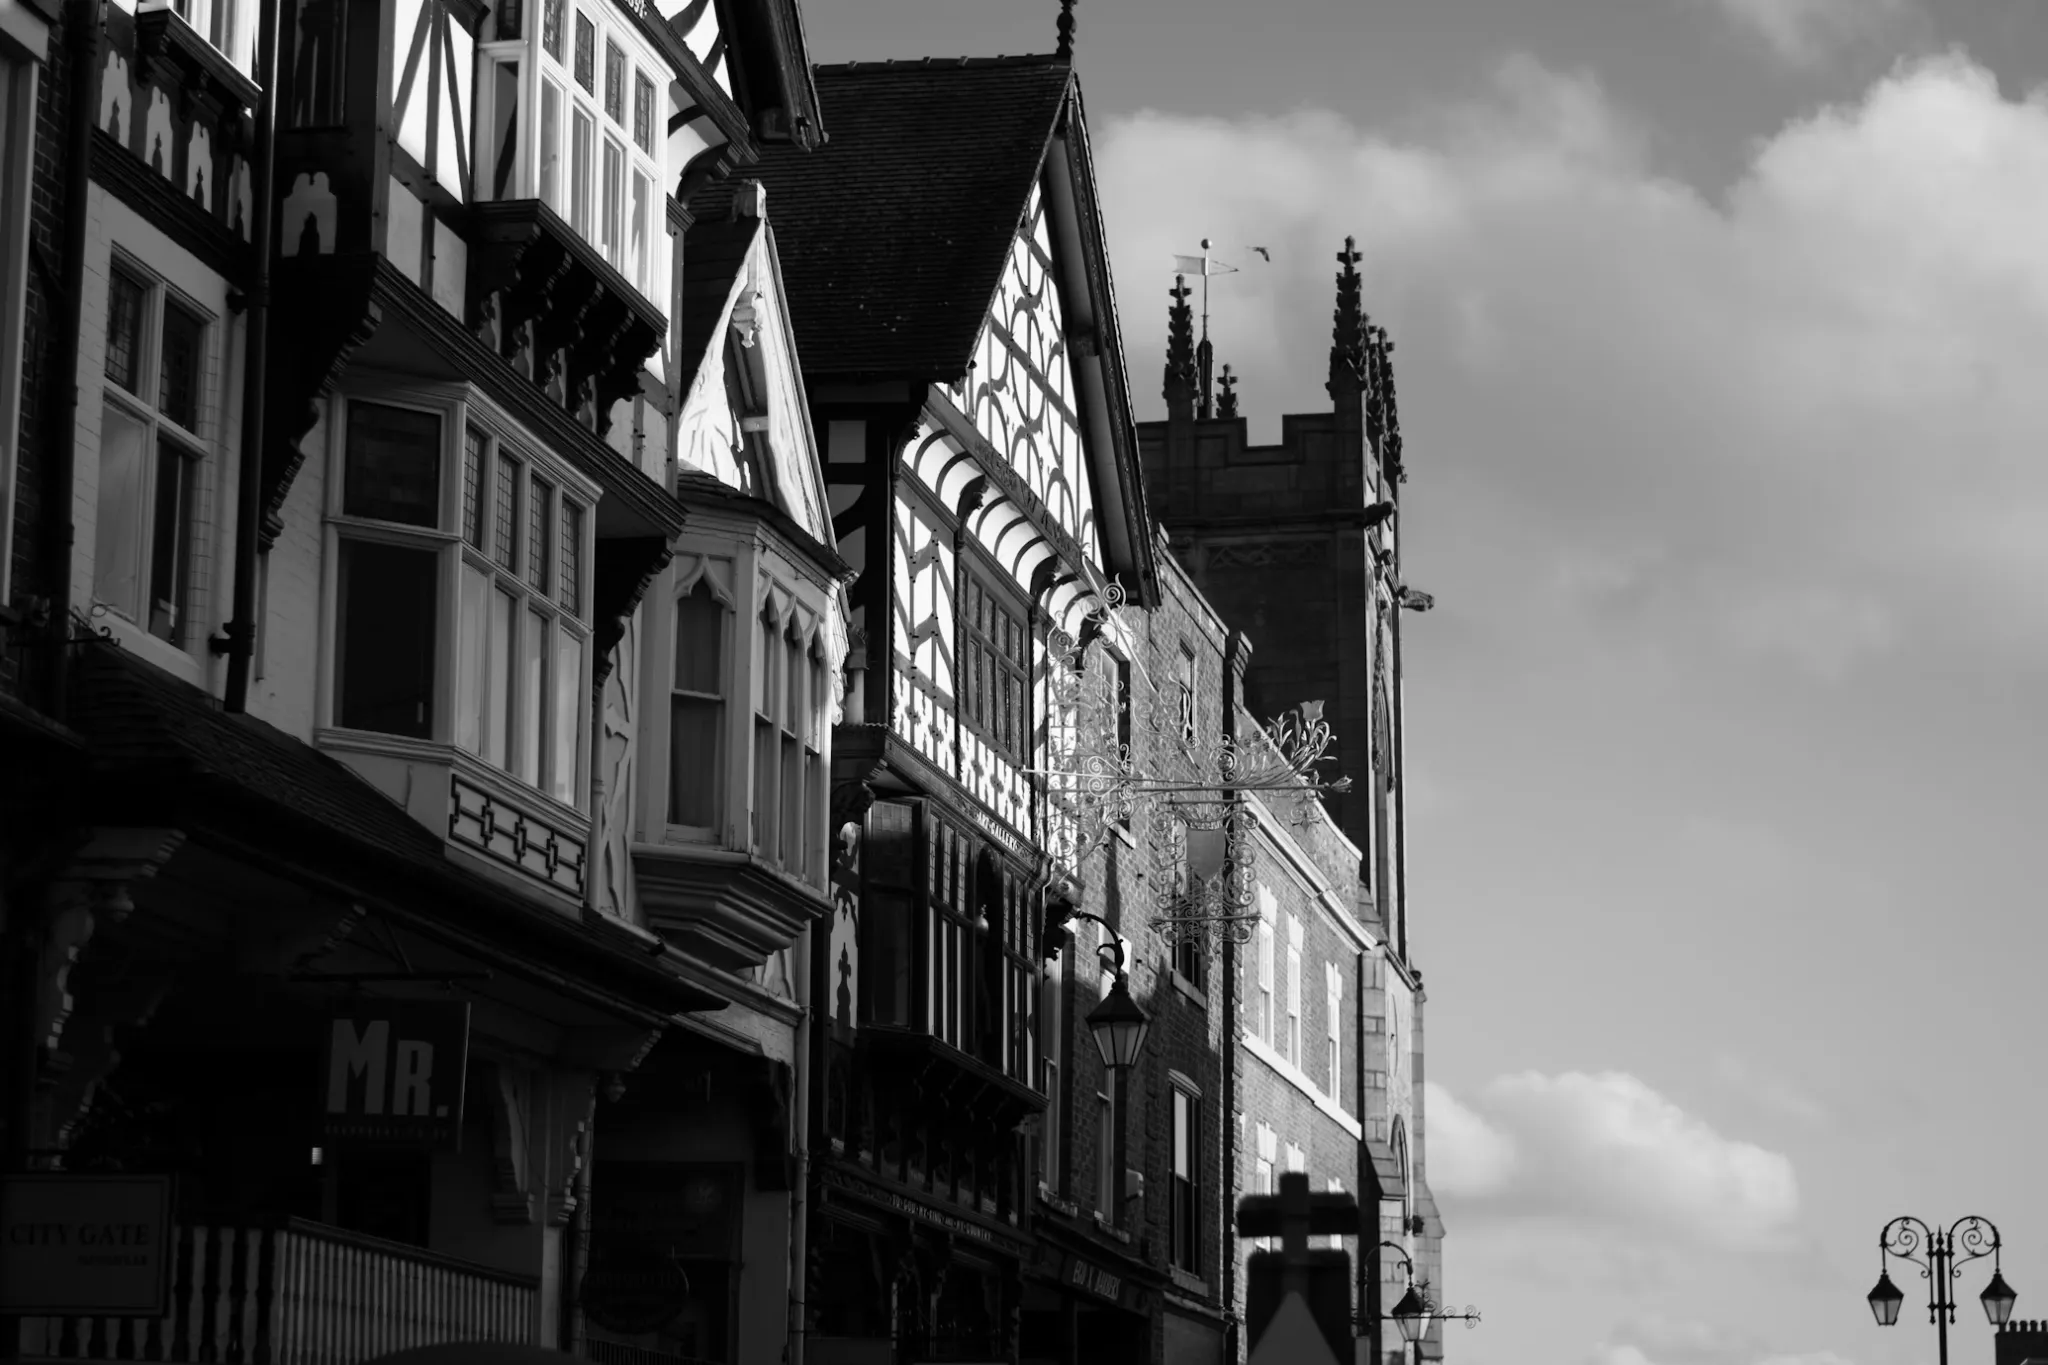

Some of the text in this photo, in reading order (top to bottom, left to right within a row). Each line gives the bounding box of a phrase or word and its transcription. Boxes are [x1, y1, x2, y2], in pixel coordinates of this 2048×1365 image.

[327, 1019, 449, 1117] MR.
[10, 1223, 149, 1246] CITY GATE
